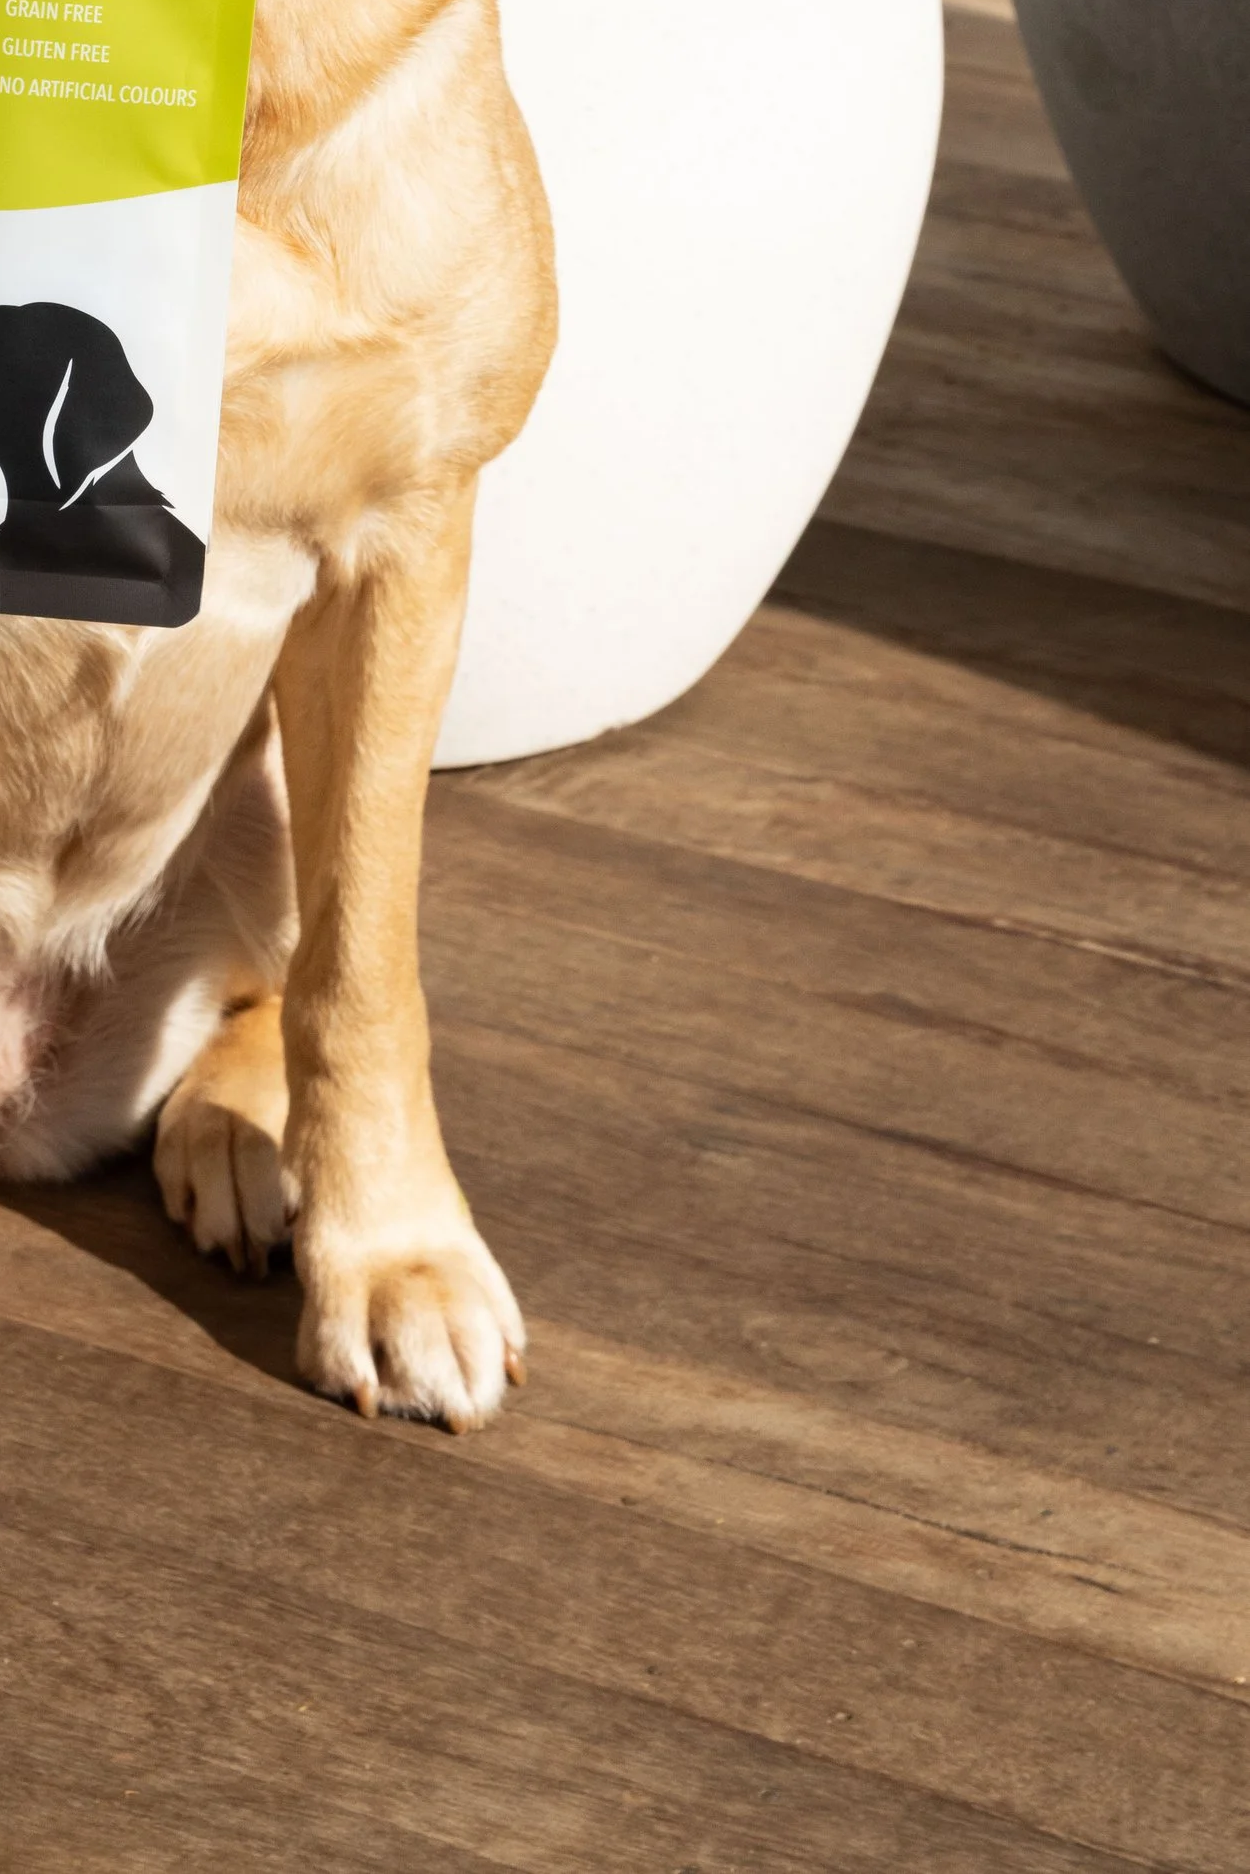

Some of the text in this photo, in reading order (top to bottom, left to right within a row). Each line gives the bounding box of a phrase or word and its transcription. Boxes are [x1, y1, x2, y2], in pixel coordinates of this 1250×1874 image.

[63, 3, 104, 24] FREE
[2, 37, 111, 63] GLUTEN FREE
[0, 76, 198, 108] NO ARTIFICIAL COLOURS
